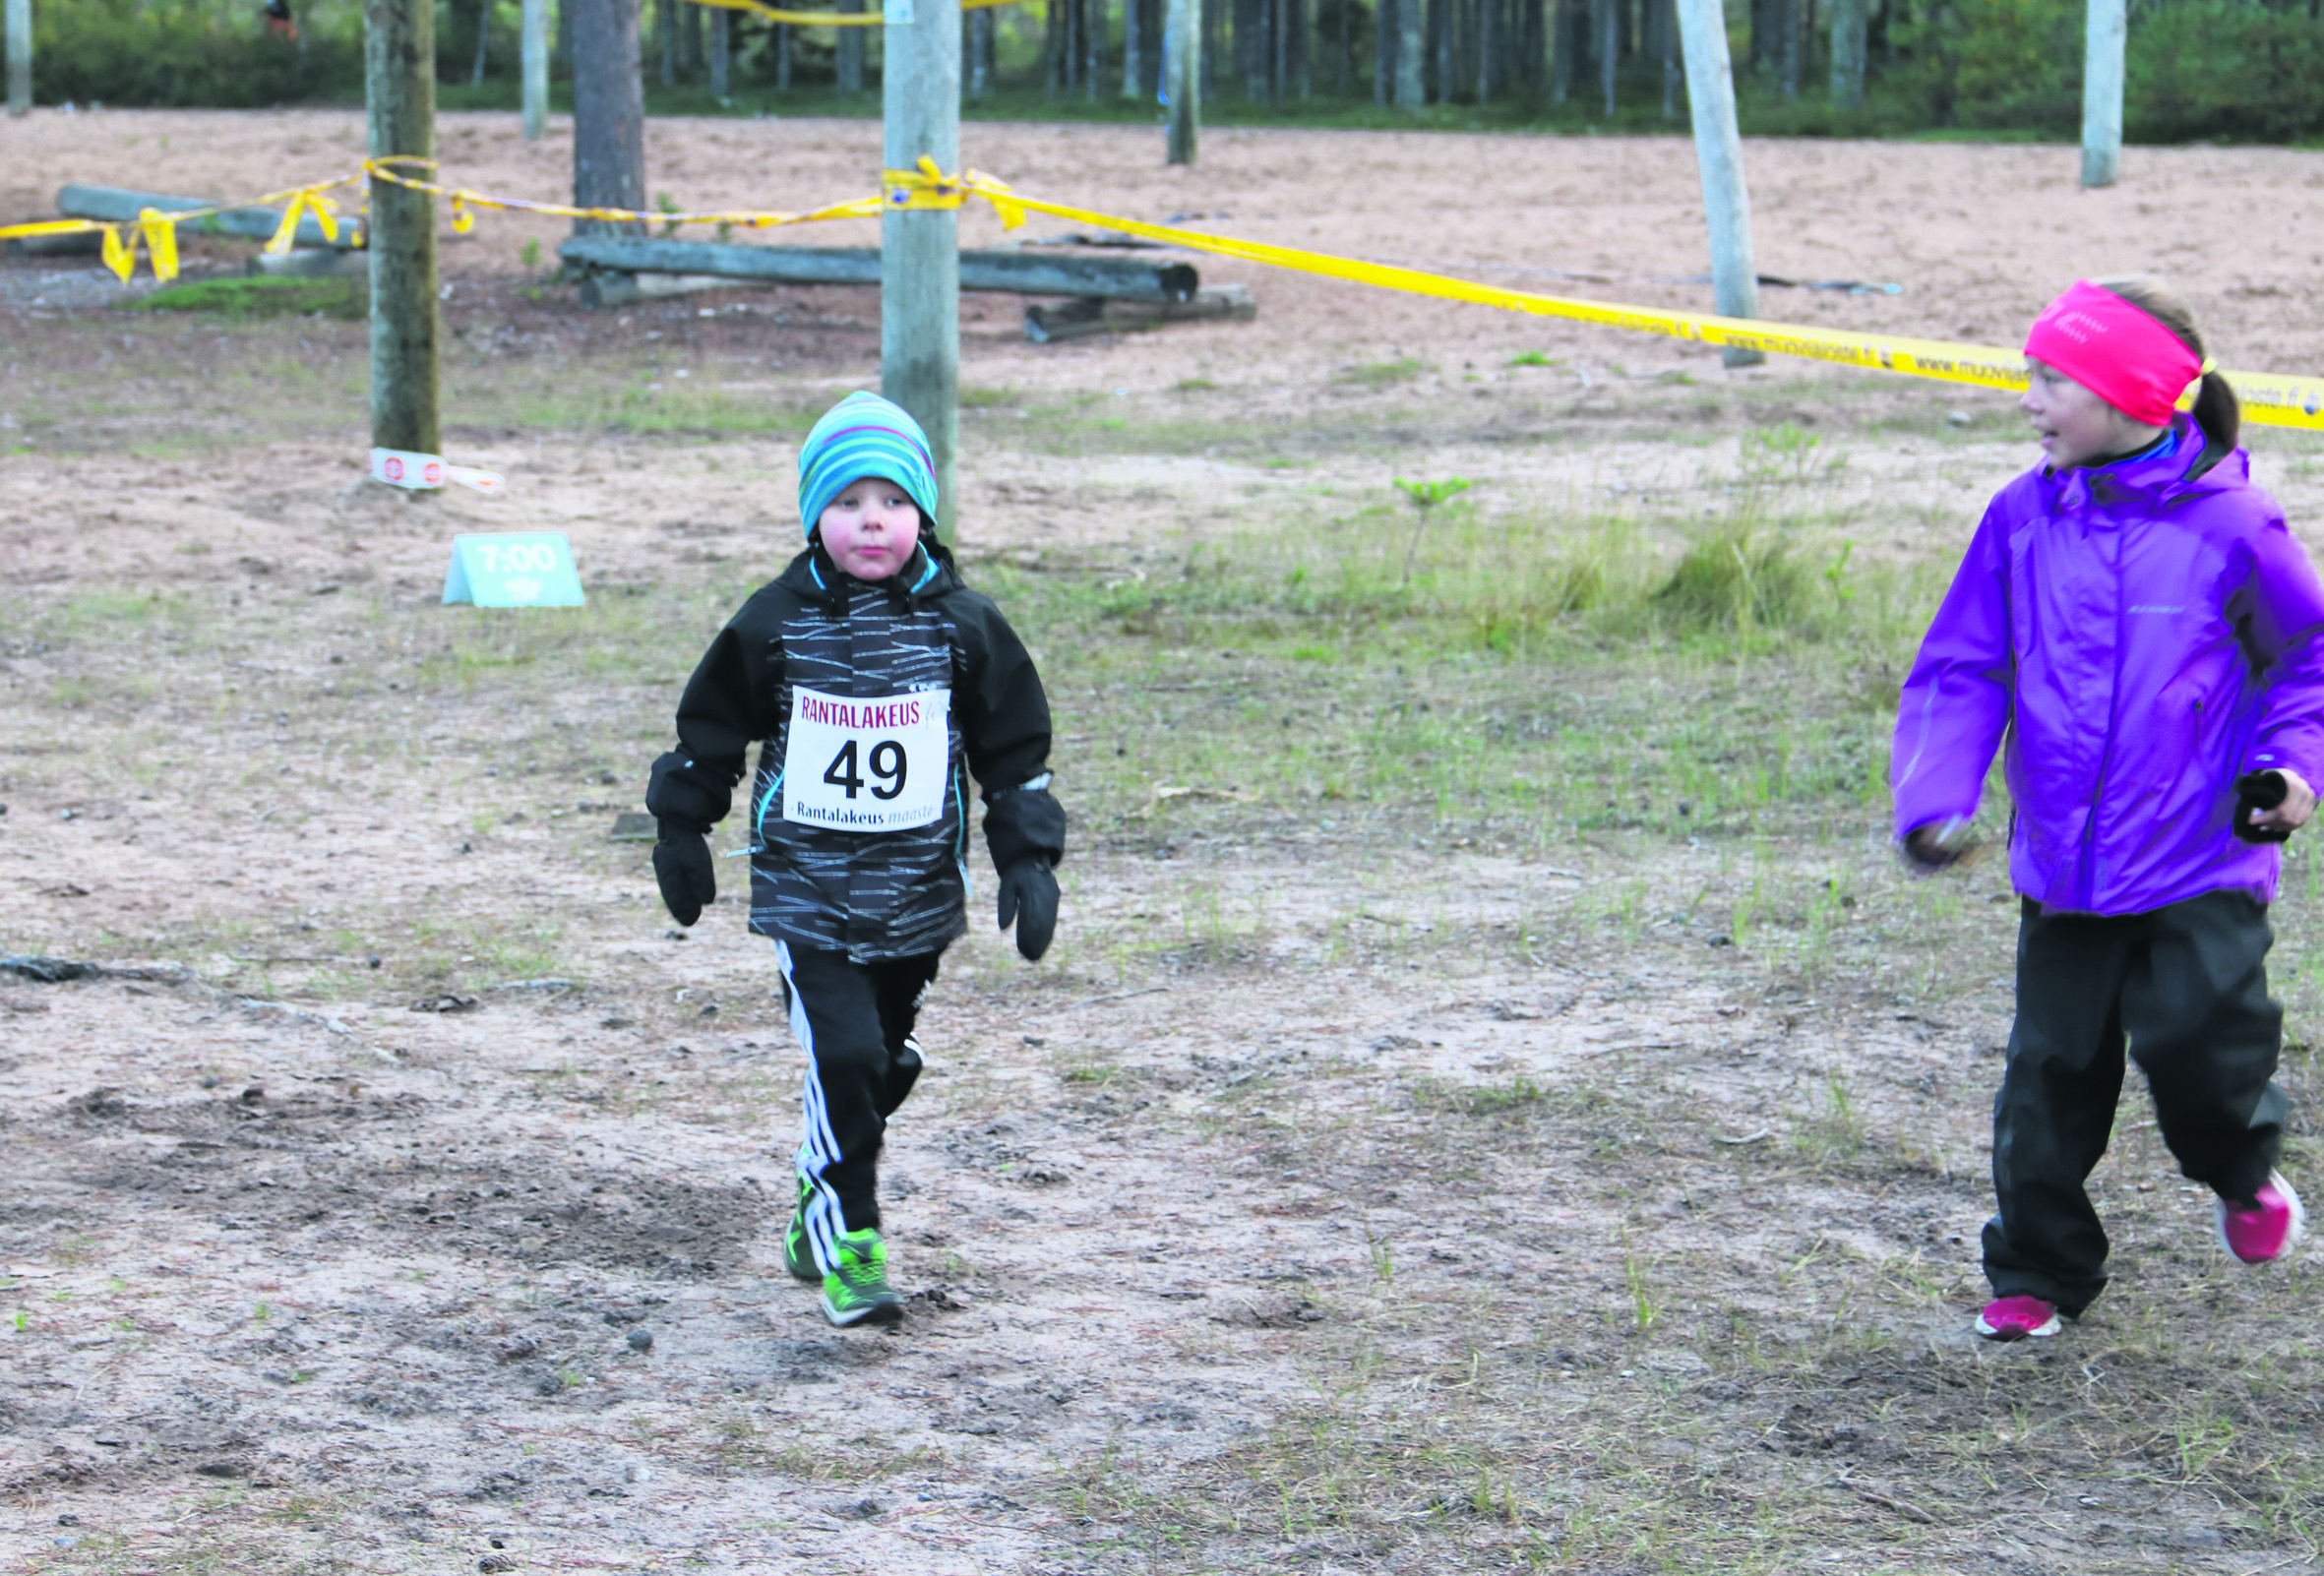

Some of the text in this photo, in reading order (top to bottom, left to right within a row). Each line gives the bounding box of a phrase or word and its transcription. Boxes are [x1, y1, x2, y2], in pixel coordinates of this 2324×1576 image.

[476, 543, 557, 574] 7:00
[824, 740, 907, 800] 49
[797, 802, 885, 824] Rantalakeus
